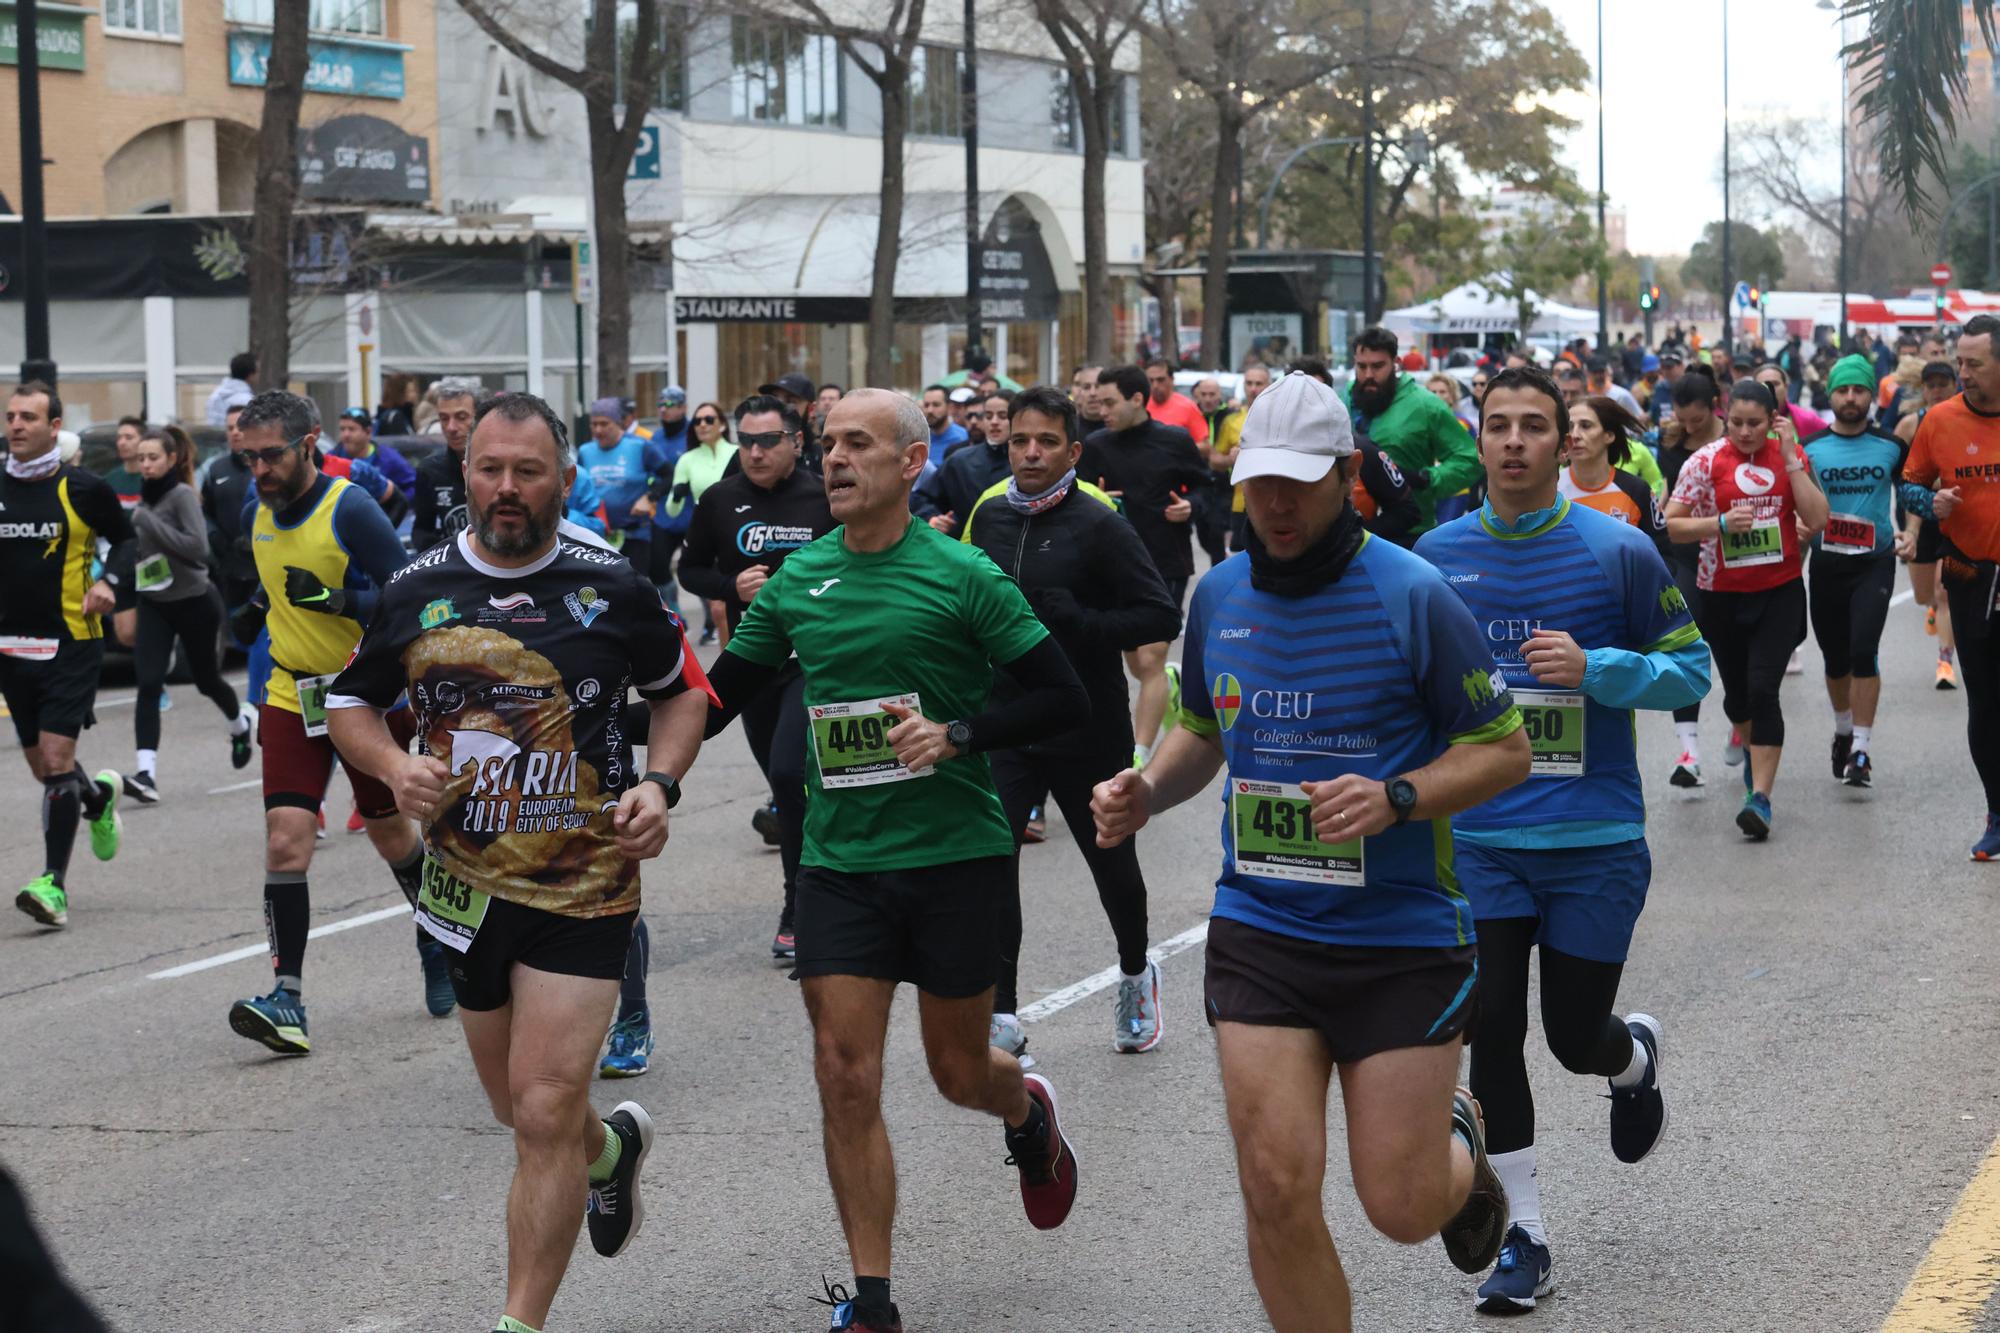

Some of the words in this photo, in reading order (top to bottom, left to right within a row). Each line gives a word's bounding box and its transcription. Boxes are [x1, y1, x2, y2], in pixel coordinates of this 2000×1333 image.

[1246, 318, 1286, 333] TOUS
[1820, 465, 1885, 483] CRESPO
[1730, 528, 1770, 551] 4461
[1829, 519, 1868, 541] 3052
[1220, 628, 1251, 639] FLOWER
[1487, 619, 1544, 642] CEU
[1491, 647, 1527, 663] Coleg
[1501, 668, 1530, 678] lencia
[490, 685, 544, 698] ALJOMAR
[1251, 689, 1315, 720] CEU
[1253, 728, 1303, 746] Colegio
[1305, 731, 1333, 746] San
[1336, 733, 1378, 749] Pablo
[1254, 754, 1295, 767] Valencia
[463, 800, 510, 832] 2019
[518, 797, 576, 816] EUROPEAN
[515, 816, 544, 833] CITY
[546, 815, 560, 831] OF
[562, 812, 593, 830] SPORT
[1253, 799, 1319, 842] 431
[1265, 854, 1323, 868] #ValènciaCorre
